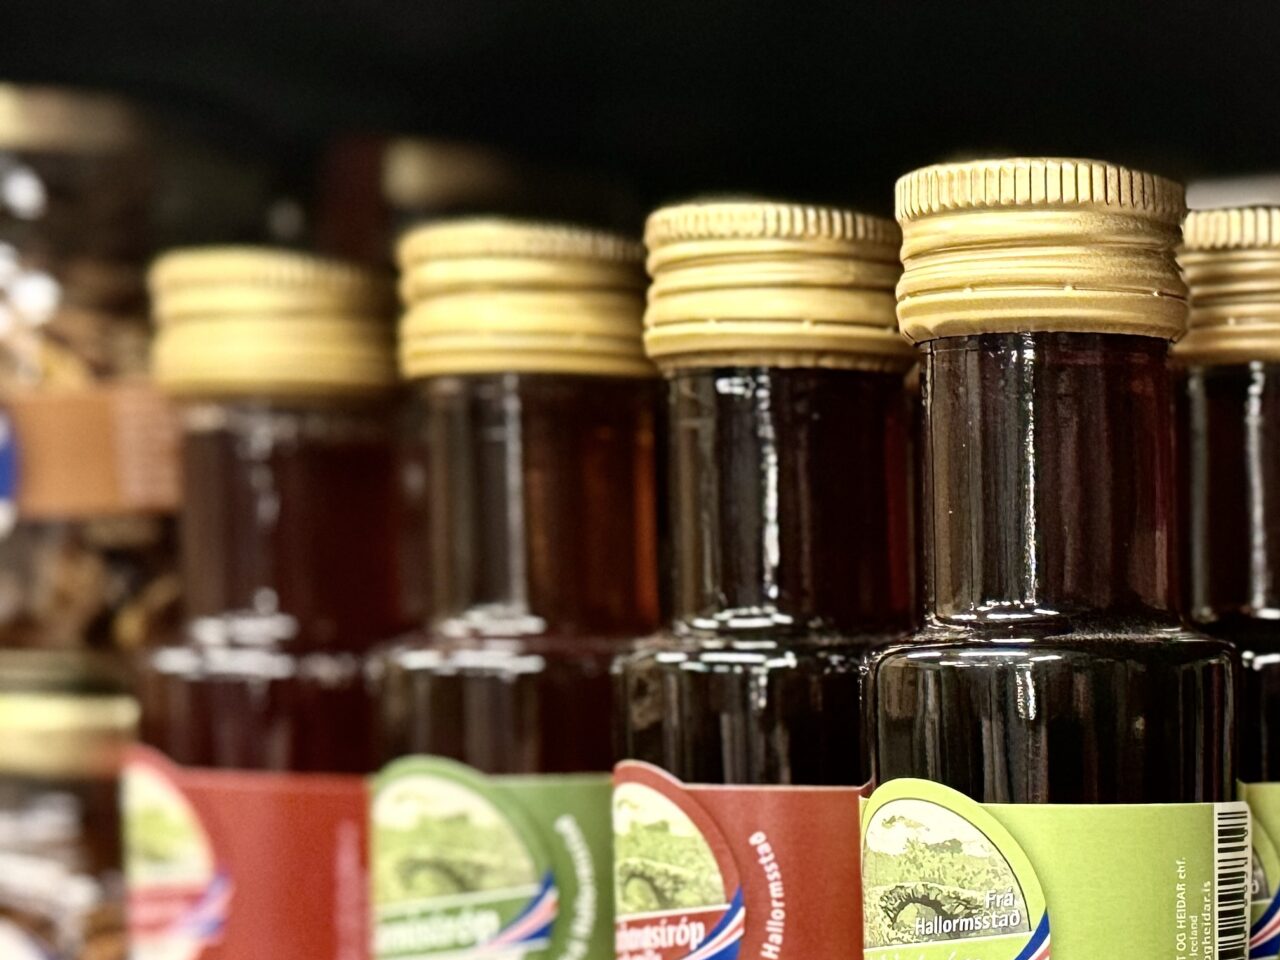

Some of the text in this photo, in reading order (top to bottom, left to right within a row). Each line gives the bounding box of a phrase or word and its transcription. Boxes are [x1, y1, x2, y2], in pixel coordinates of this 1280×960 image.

[984, 888, 1015, 908] Frá
[915, 913, 1021, 937] Hallormsstað
[1176, 932, 1187, 952] OG
